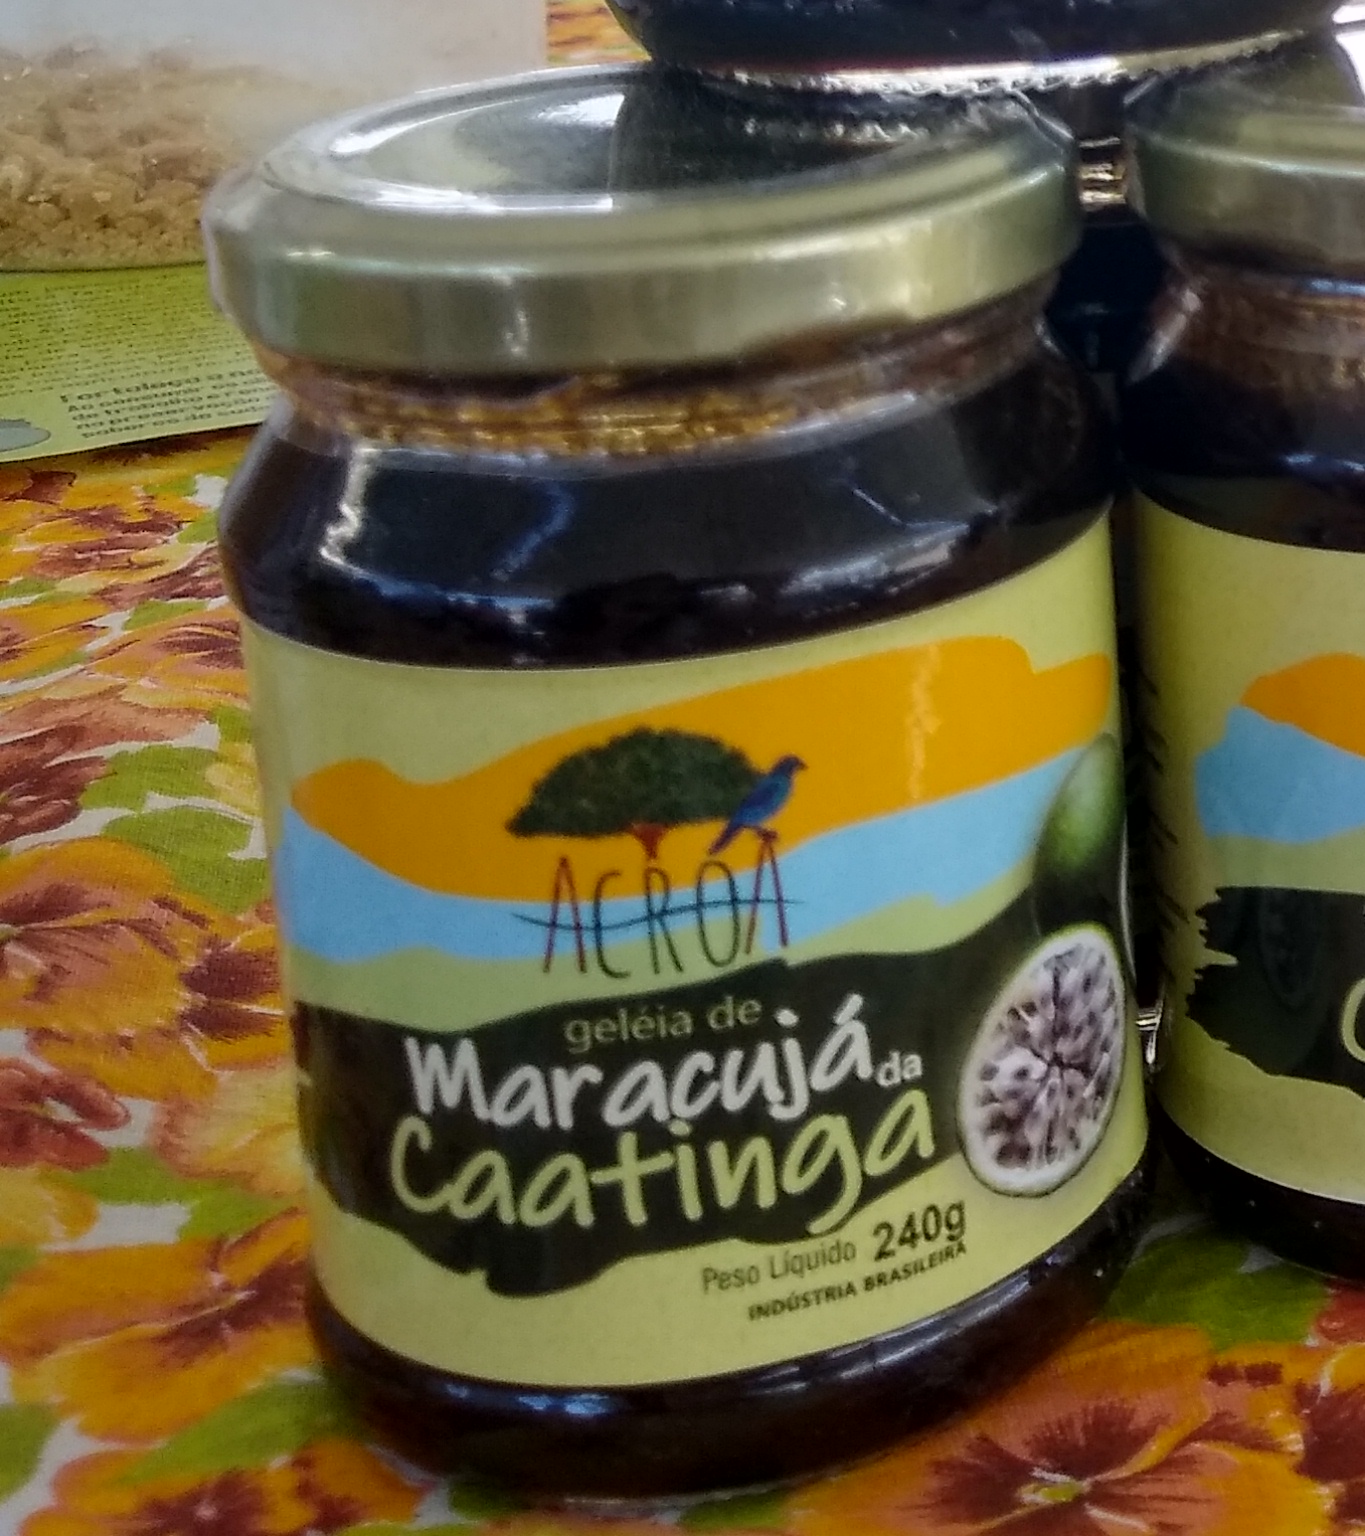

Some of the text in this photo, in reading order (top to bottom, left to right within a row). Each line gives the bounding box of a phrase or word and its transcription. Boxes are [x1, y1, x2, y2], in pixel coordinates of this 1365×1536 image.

[405, 992, 924, 1132] Maracujá da
[564, 994, 762, 1054] geléia de
[390, 1089, 937, 1236] Caatinga
[702, 1199, 966, 1294] Peso Líquido 240g
[747, 1239, 967, 1321] INDÚSTRIA BRASILEIRA
